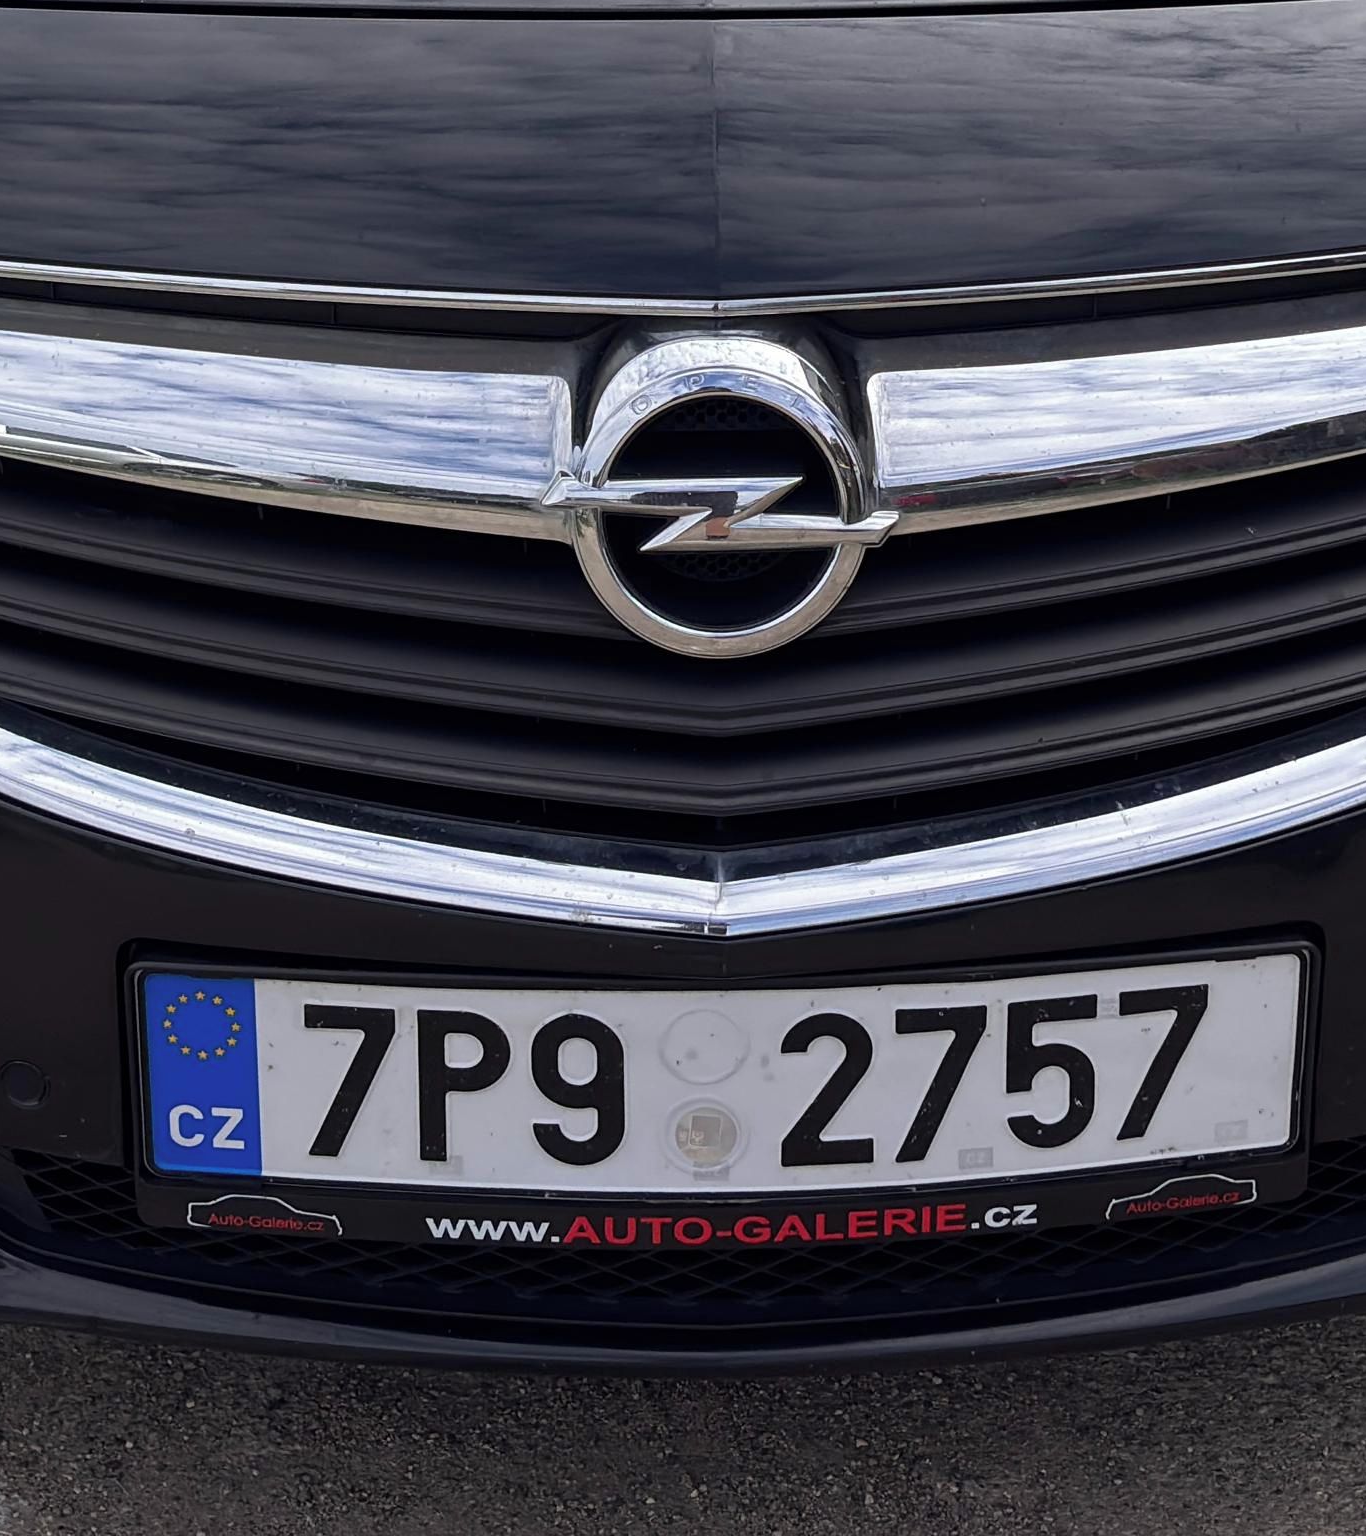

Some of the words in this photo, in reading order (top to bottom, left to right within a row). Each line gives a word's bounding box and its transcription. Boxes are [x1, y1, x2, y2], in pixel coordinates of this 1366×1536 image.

[303, 1003, 626, 1167] 7P9
[779, 983, 1210, 1167] 2757
[169, 1104, 245, 1150] CZ
[425, 1202, 1038, 1246] www.AUTO-GALERIE.cz
